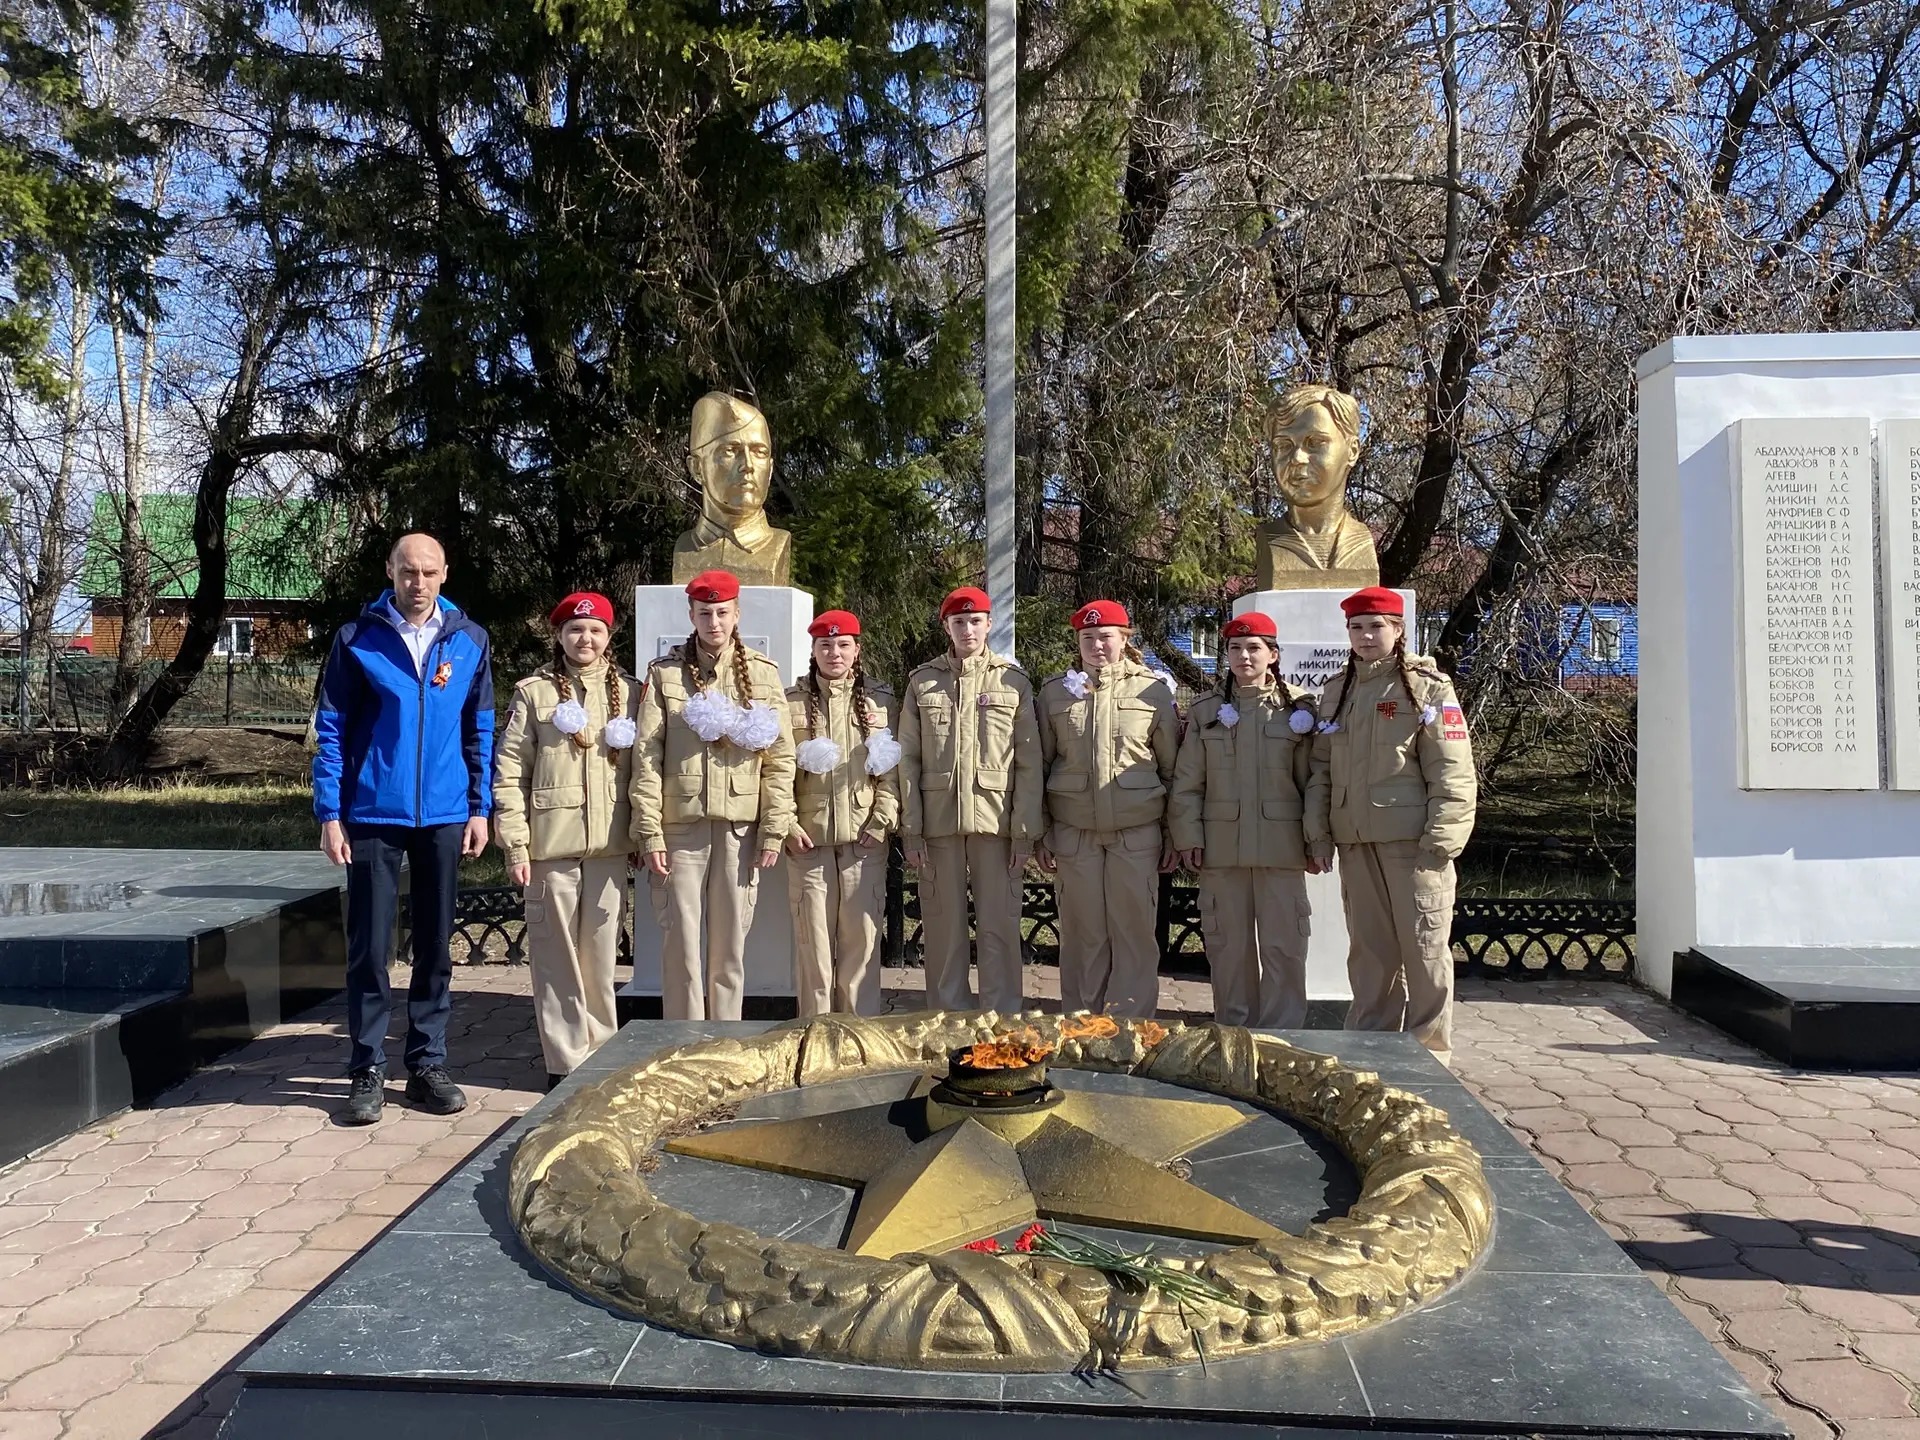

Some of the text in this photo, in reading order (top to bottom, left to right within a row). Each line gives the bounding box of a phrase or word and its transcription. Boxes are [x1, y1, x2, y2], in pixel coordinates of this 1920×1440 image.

[1765, 459, 1818, 468] АВДЮКОВ
[1765, 471, 1796, 480] АГЕЕВ
[1765, 483, 1817, 492] АЛИШИН
[1765, 496, 1815, 505] АНИКИН
[1766, 508, 1822, 517] АНУФРИЕВ
[1766, 520, 1826, 529] АРНАЦКИЙ
[1766, 533, 1827, 542] АРНАЦКИЙ
[1766, 545, 1821, 554] БАЖЕНОВ
[1766, 557, 1821, 566] БАЖЕНОВ
[1766, 569, 1821, 578] БАЖЕНОВ
[1767, 582, 1818, 590] БАКАНОВ
[1767, 594, 1822, 603] БАЛАЛАЕВ
[1767, 606, 1826, 615] БАЛАНТАЕВ
[1768, 619, 1827, 627] БАЛАНТАЕВ
[1768, 631, 1829, 640] БАНДЮКОВ
[1768, 643, 1830, 652] БЕЛОРУСОВ
[1768, 655, 1828, 665] БЕРЕЖНОЙ
[1769, 668, 1814, 677] БОБКОВ
[1769, 680, 1814, 689] БОБКОВ
[1770, 693, 1815, 702] БОБРОВ
[1770, 705, 1822, 714] БОРИСОВ
[1770, 718, 1822, 727] БОРИСОВ
[1771, 730, 1822, 739] БОРИСОВ
[1771, 742, 1823, 752] БОРИСОВ
